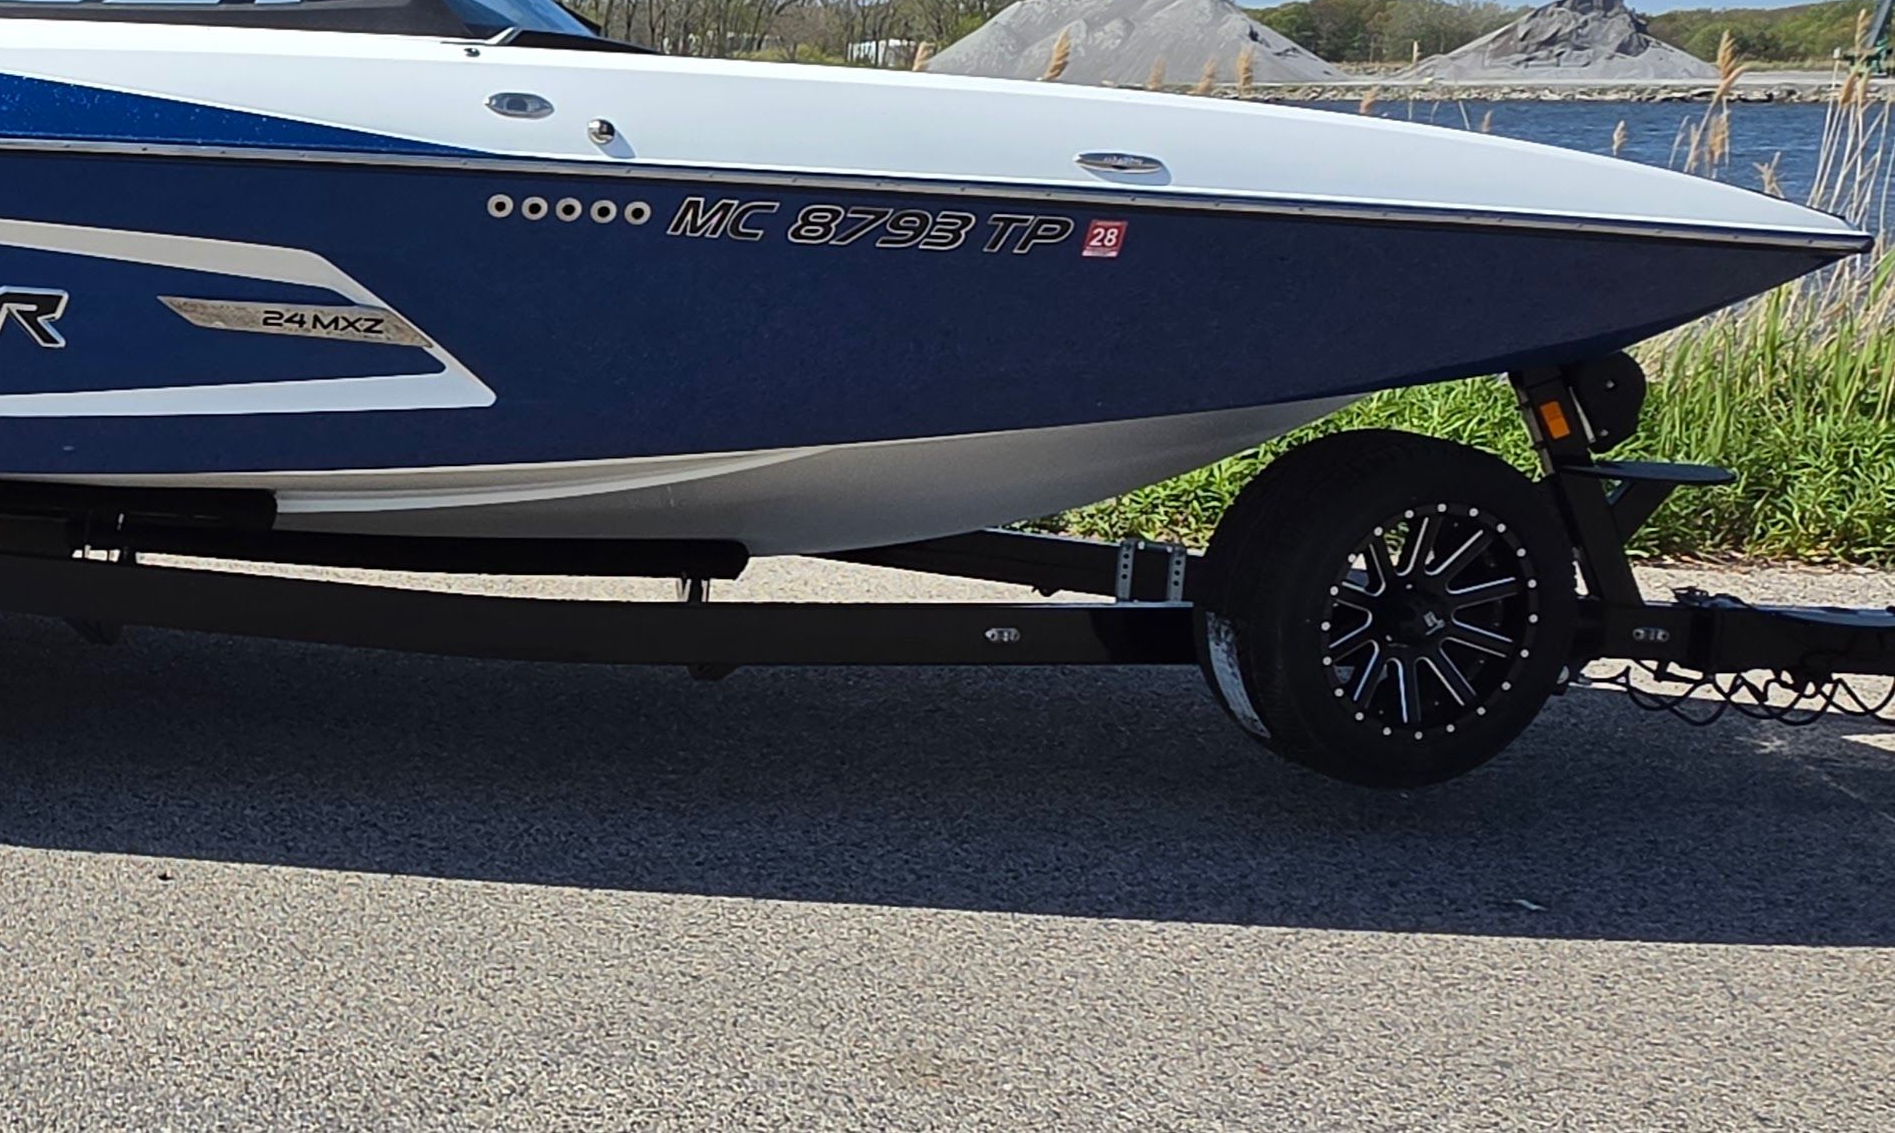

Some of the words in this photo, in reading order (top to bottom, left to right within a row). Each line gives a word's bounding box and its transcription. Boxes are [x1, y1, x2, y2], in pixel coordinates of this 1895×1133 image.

[666, 196, 780, 241] MC
[787, 204, 975, 251] 8793
[983, 213, 1075, 254] TP
[1089, 227, 1118, 247] 28
